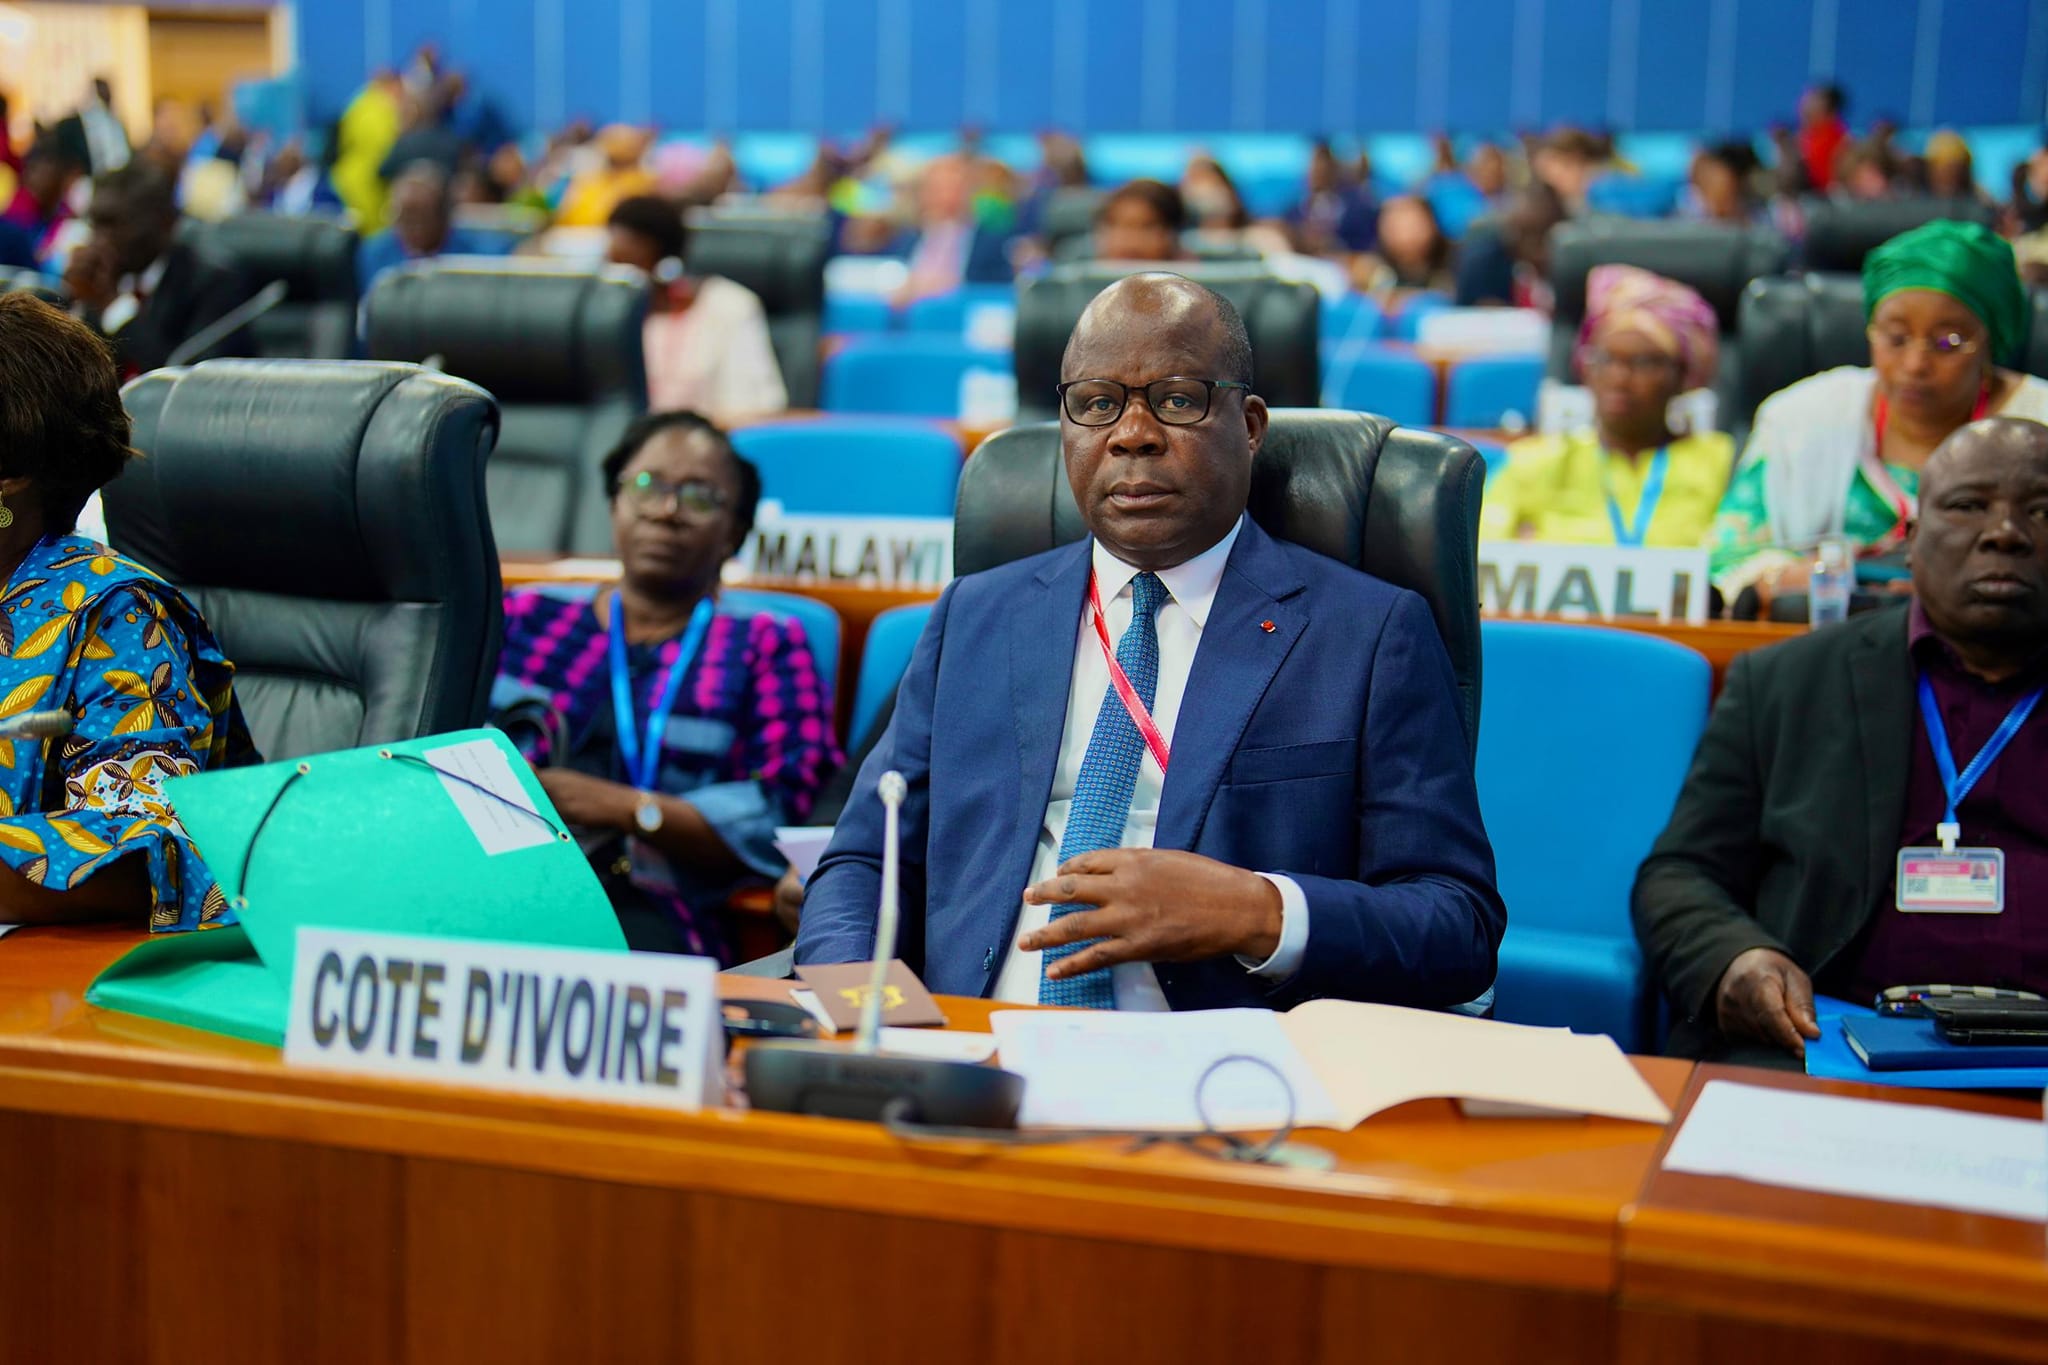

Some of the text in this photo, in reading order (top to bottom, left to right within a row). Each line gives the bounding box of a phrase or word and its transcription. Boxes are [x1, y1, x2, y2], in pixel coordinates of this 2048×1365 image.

[755, 531, 944, 583] MALAWI
[1478, 563, 1692, 619] MALI
[312, 949, 688, 1087] COTE D'IVOIRE
